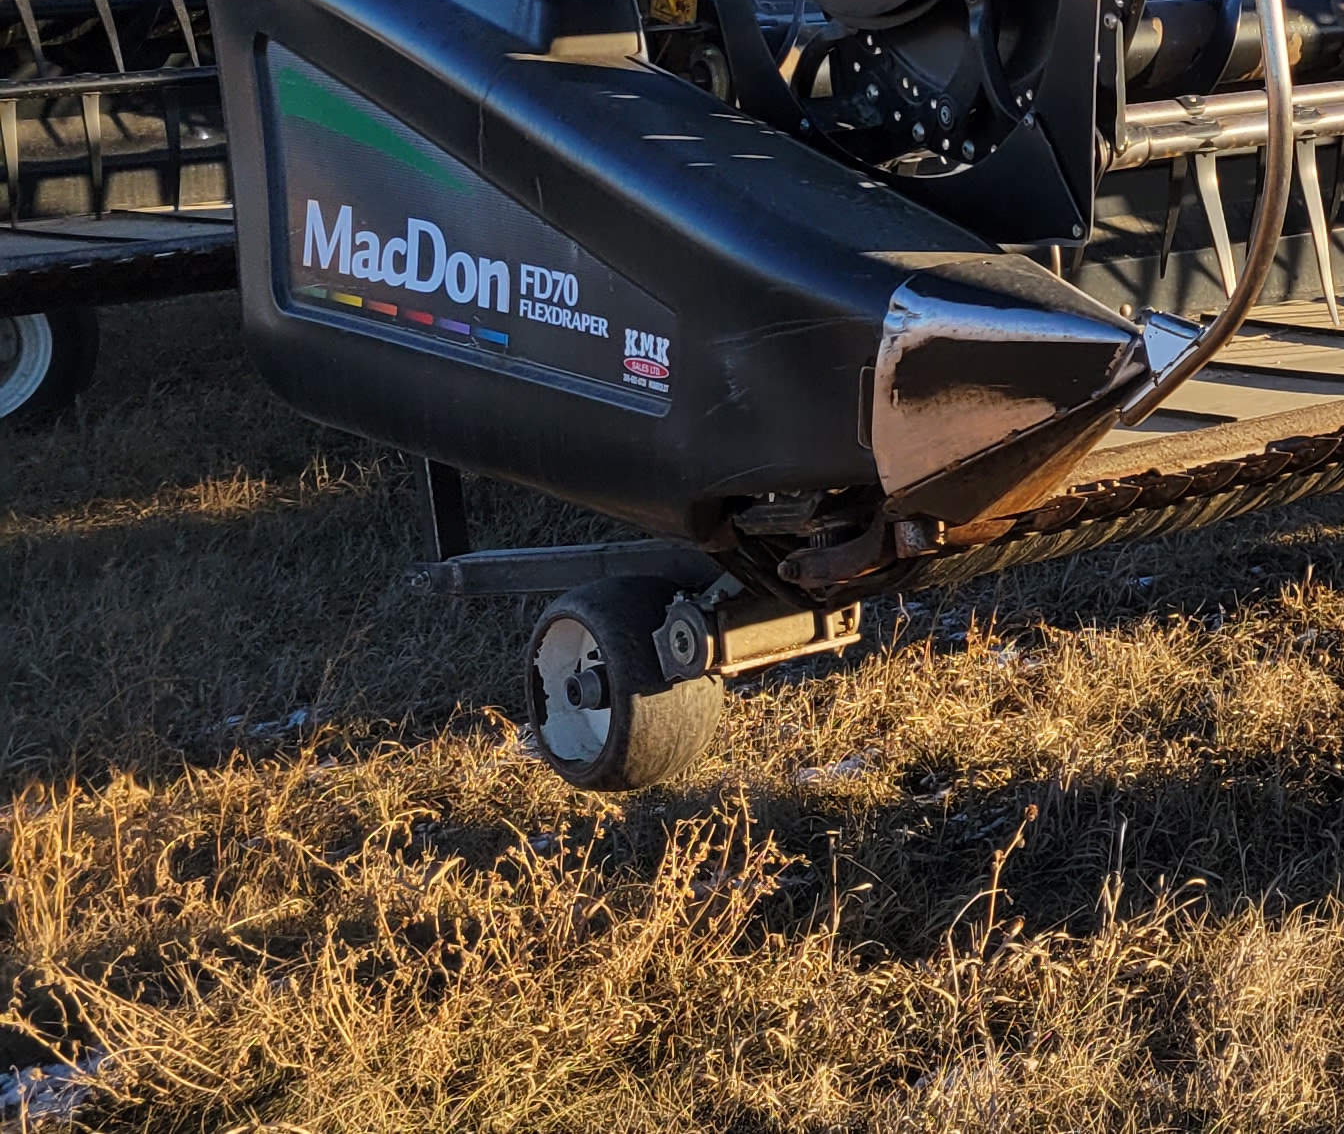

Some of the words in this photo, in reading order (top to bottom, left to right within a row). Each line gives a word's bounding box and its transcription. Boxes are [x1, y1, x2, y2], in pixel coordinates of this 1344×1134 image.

[302, 199, 511, 314] MacDon
[520, 263, 579, 307] FD70
[519, 298, 610, 339] FLEXDRAPER
